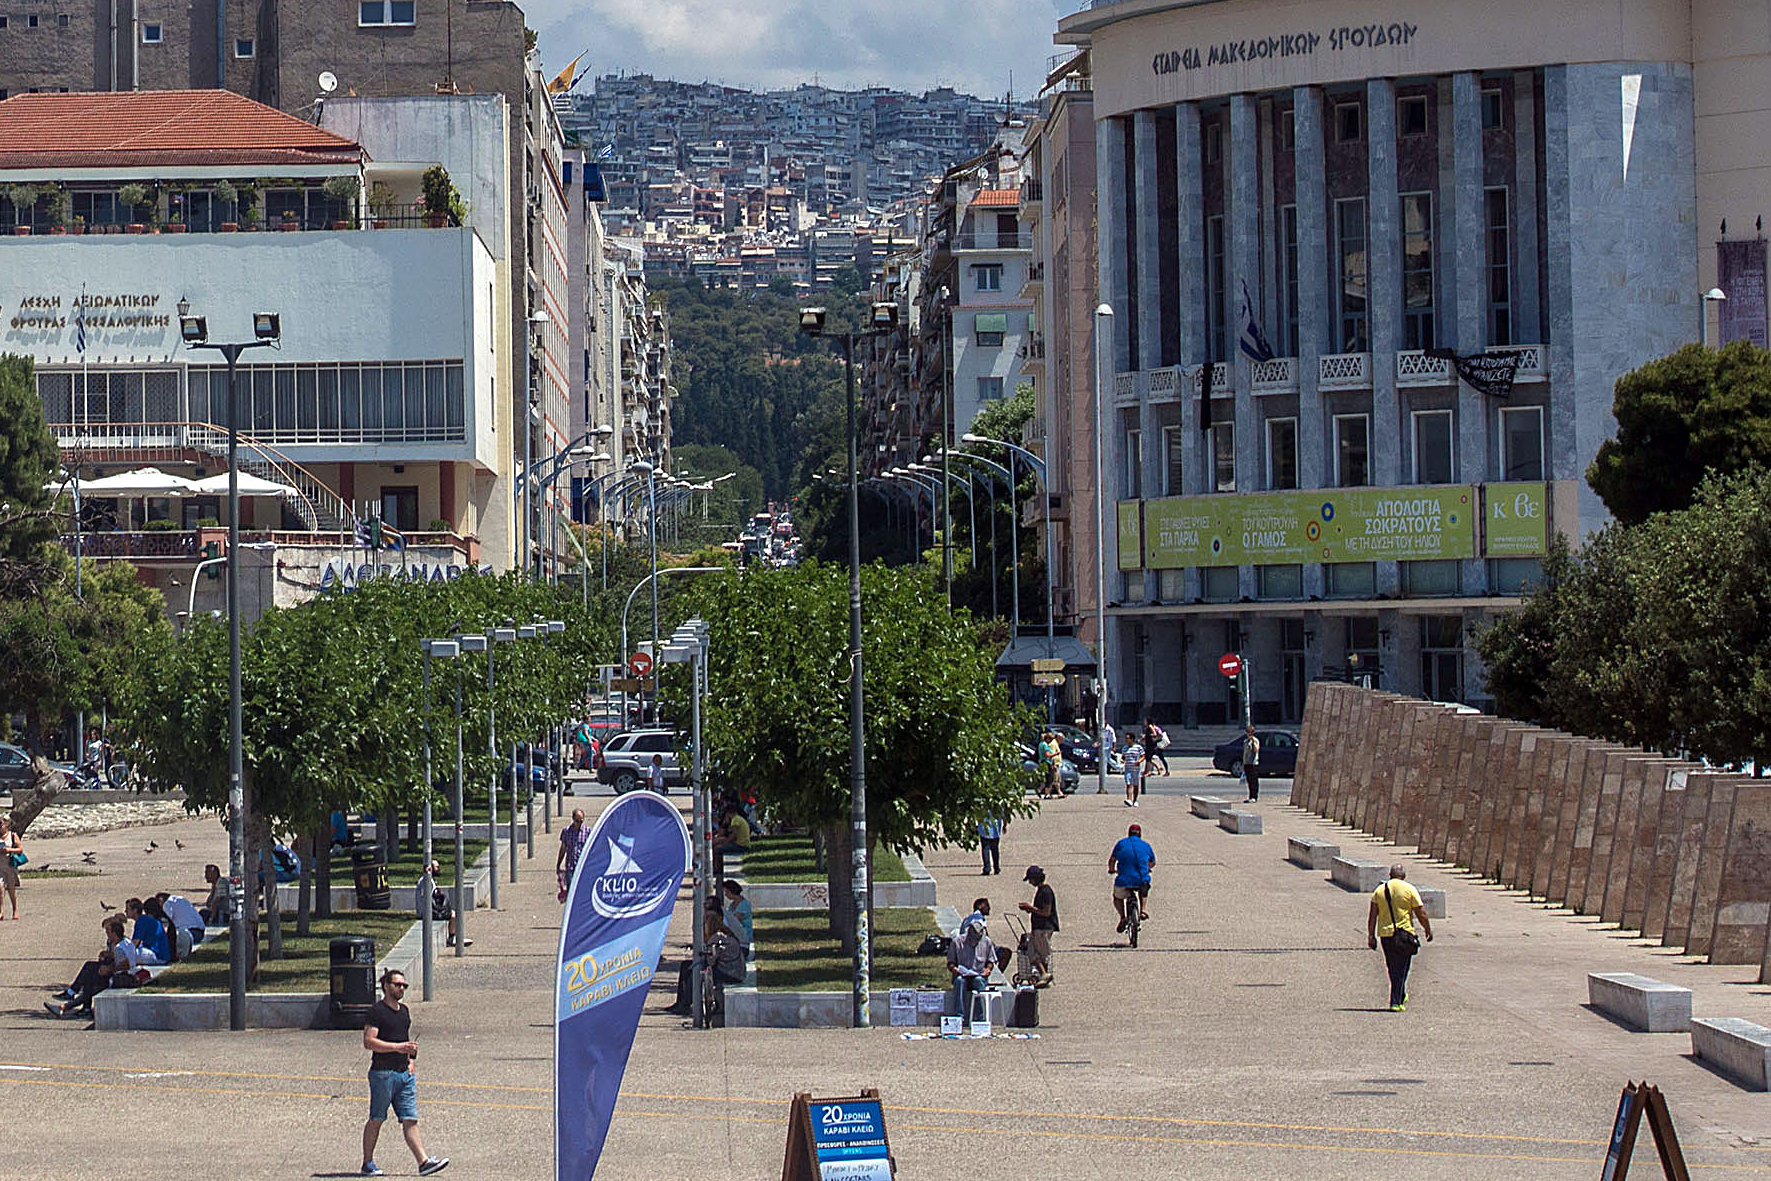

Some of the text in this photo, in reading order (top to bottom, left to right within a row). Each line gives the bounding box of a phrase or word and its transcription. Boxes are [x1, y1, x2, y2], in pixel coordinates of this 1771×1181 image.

[1152, 48, 1201, 75] ΕΤΑΙΡΕΙΑ
[1208, 31, 1321, 67] ΜΑΚΕΔΟΝΙΚΩΝ
[20, 295, 61, 308] ΛΕΣΧΗ
[10, 316, 67, 329] ΦΡΟΥΡΑΣ
[1376, 499, 1441, 517] ΑΠΟΛΟΓΙΑ
[1365, 516, 1442, 534] ΣΩΚΡΑΤΟΥΣ
[1252, 531, 1287, 547] ΓΑΜΟΣ
[1371, 537, 1394, 549] ΔΥΣΗ
[1395, 536, 1413, 549] ΤΟΥ
[603, 877, 637, 892] KLIO
[564, 946, 644, 992] 20 ΧΡΟΝΙΑ
[572, 966, 651, 1011] ΚΑΡΑΒΙ ΚΛΕΙΩ
[822, 1105, 871, 1123] 20 ΧΡΟΝΙΑ
[824, 1125, 874, 1135] ΚΑΡΑΒΙ ΚΛΕΙΩ
